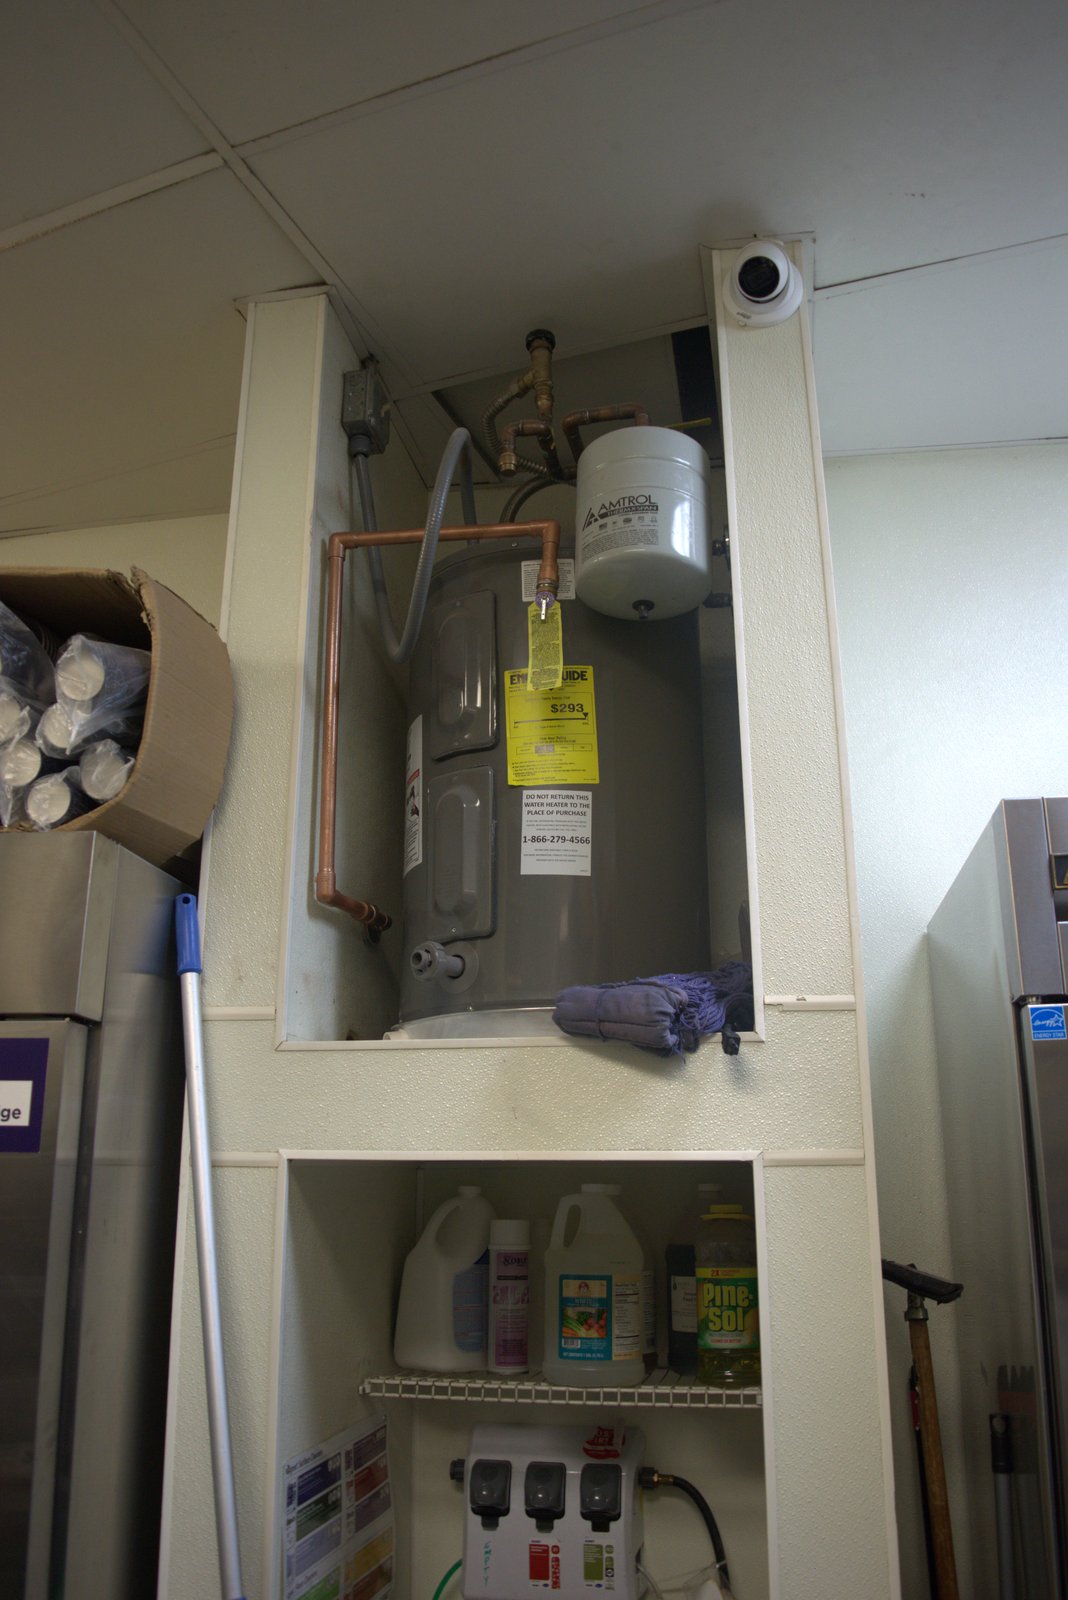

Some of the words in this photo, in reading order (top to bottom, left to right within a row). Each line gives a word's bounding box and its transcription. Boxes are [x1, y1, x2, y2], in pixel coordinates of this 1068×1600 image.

[598, 495, 657, 513] AMTROL
[550, 703, 584, 713] $293
[523, 835, 591, 845] 1-866-279-4566
[0, 1107, 22, 1122] ge
[708, 1307, 744, 1332] Sol
